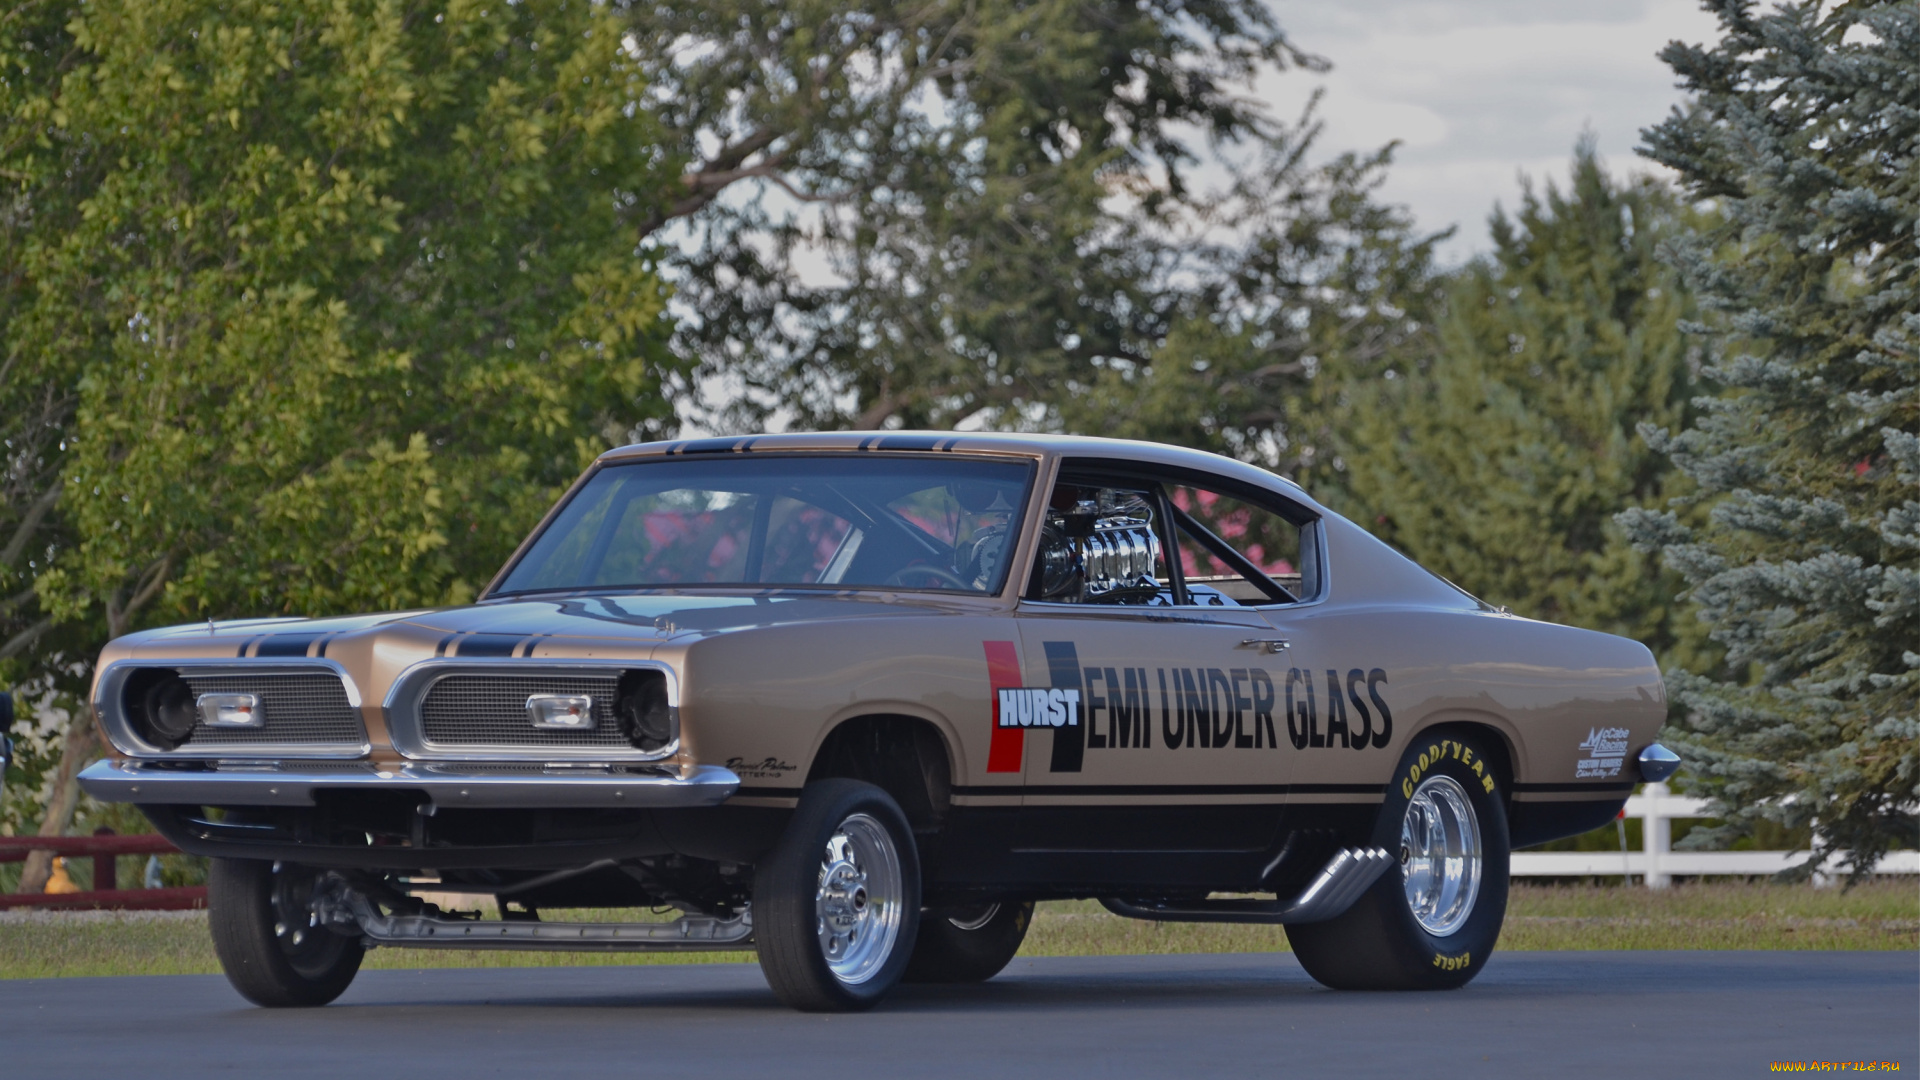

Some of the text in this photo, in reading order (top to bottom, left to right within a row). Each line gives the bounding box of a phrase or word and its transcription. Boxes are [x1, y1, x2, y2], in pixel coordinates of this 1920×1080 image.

[998, 689, 1080, 727] HURST
[1158, 667, 1278, 750] UNDER
[1285, 667, 1393, 751] GLASS
[1580, 727, 1630, 746] McCabe
[1598, 740, 1629, 752] Racing
[1402, 740, 1496, 800] GOODYEAR
[1432, 952, 1471, 971] EAGLE
